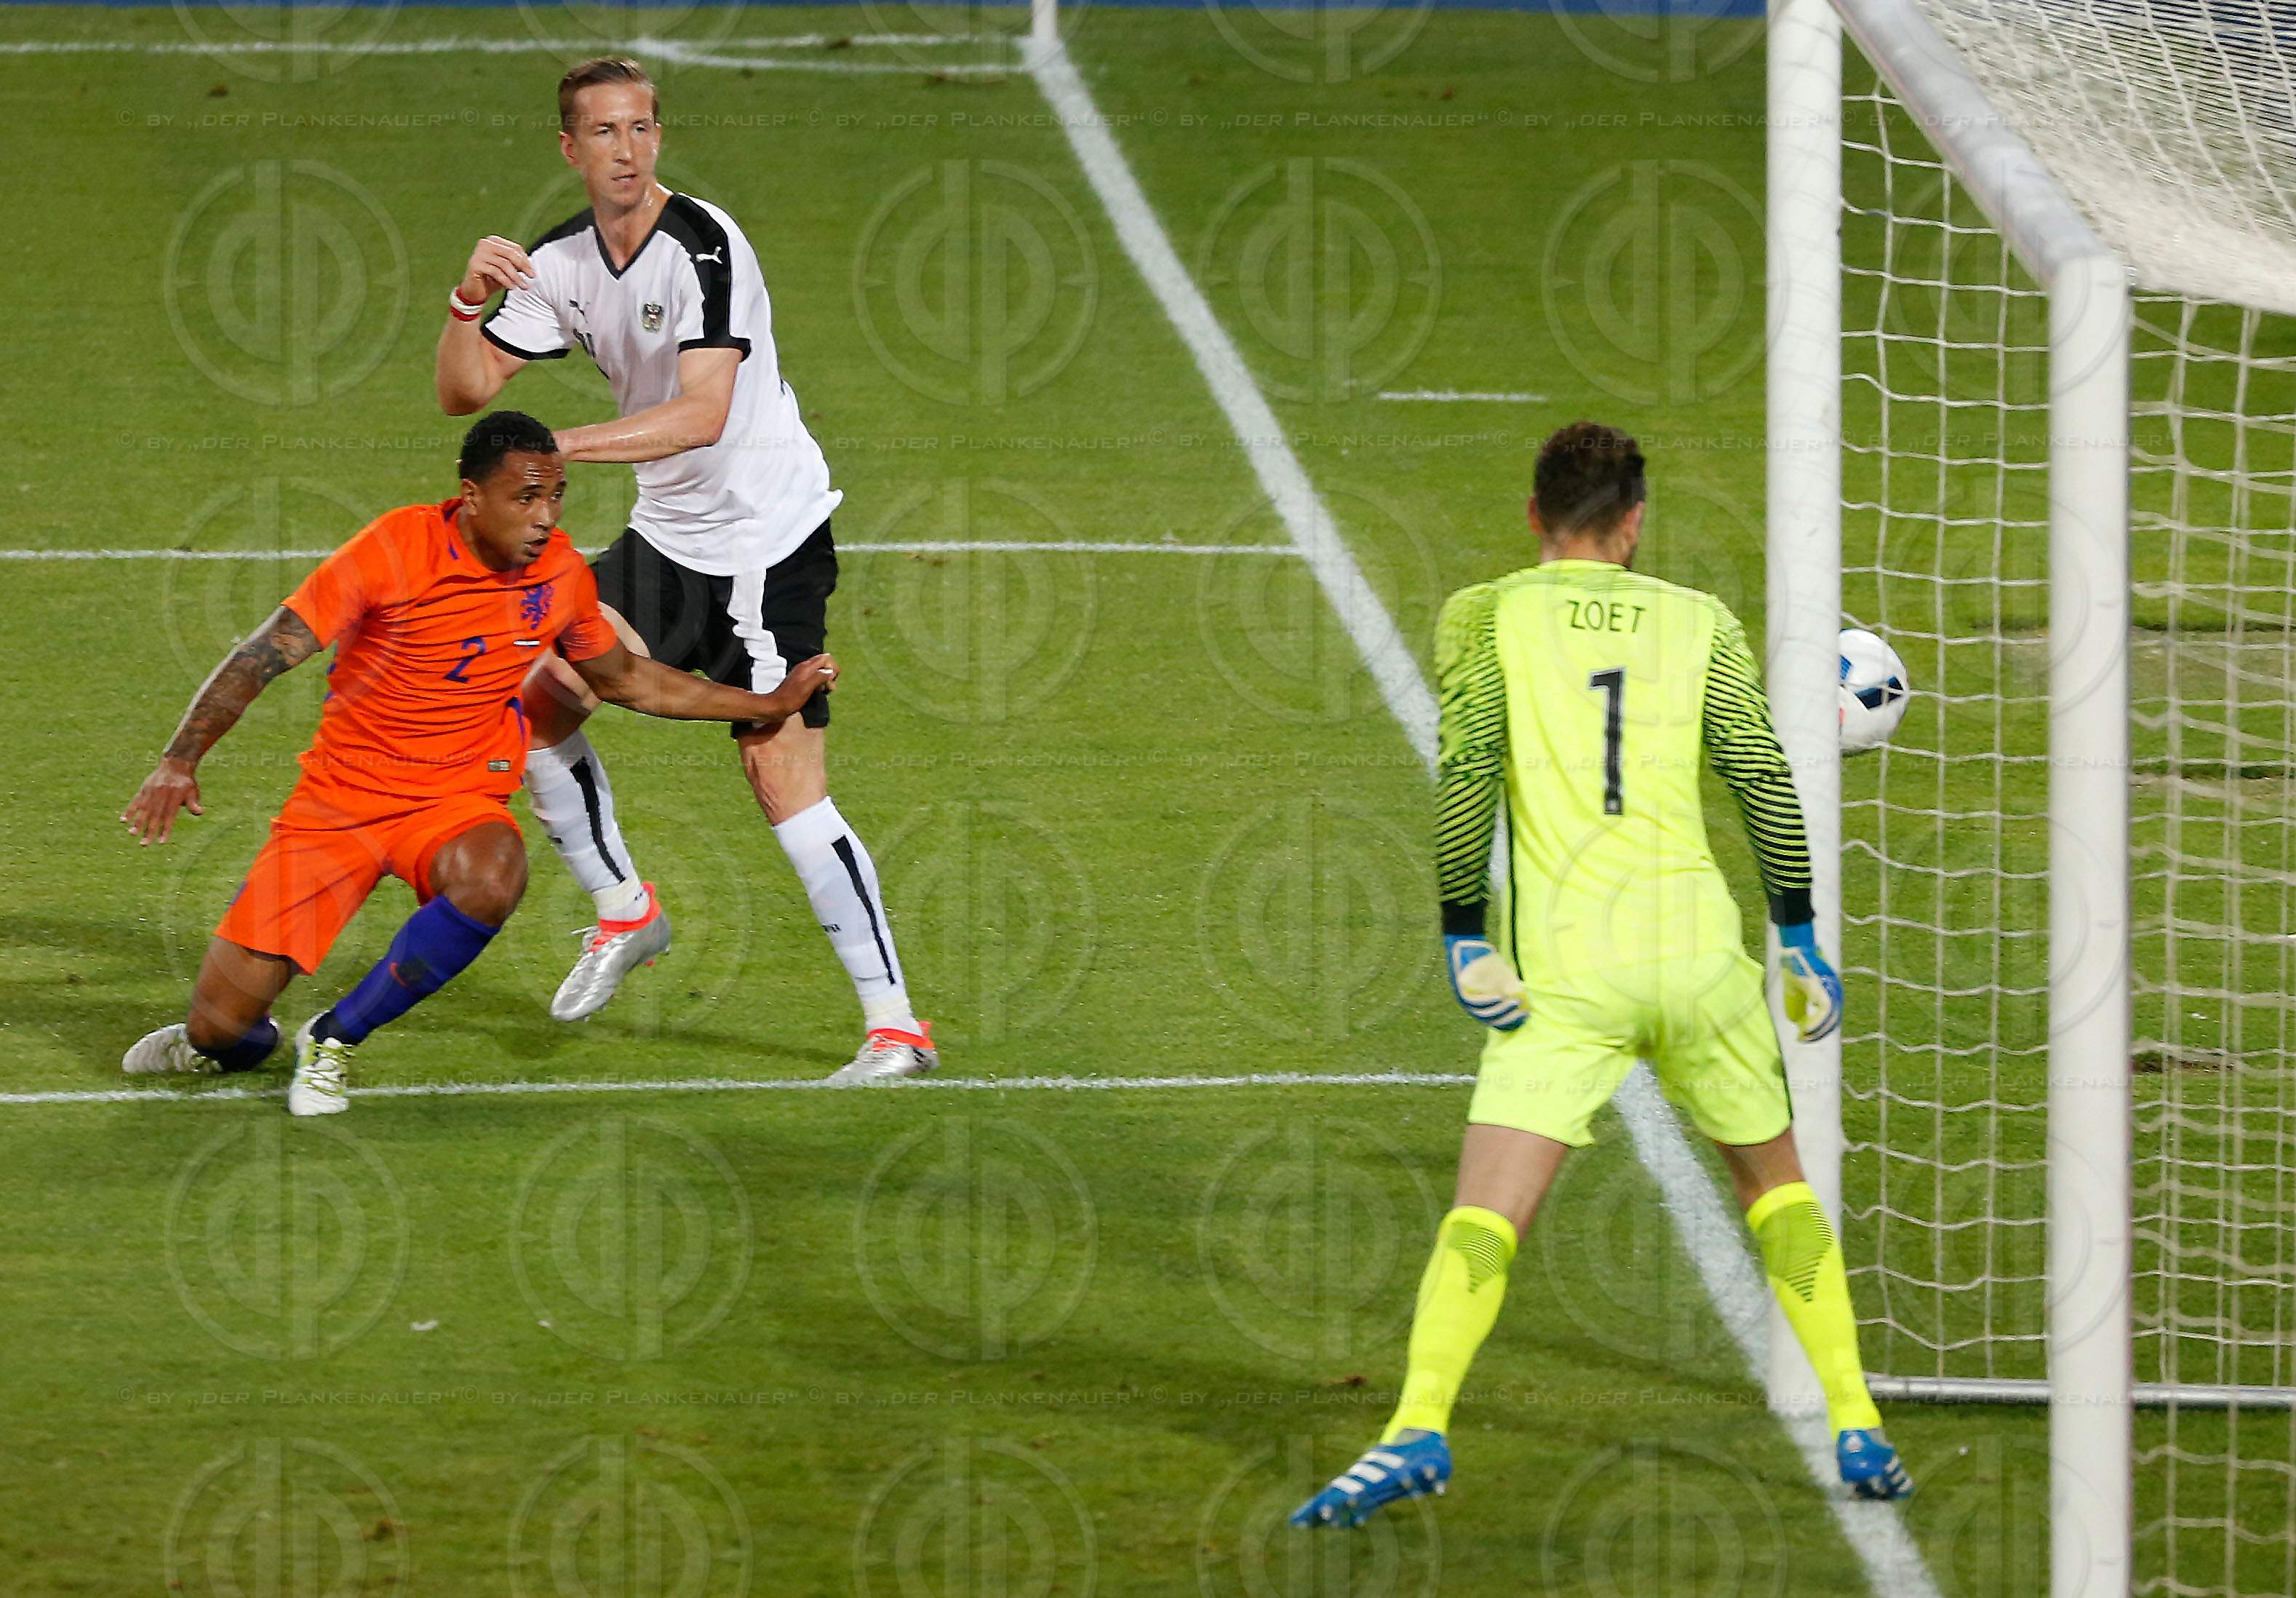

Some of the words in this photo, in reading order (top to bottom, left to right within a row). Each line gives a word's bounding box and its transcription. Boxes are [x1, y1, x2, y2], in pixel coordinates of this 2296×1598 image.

[1567, 600, 1647, 633] ZOET
[445, 636, 486, 683] 2
[1589, 665, 1627, 816] 1
